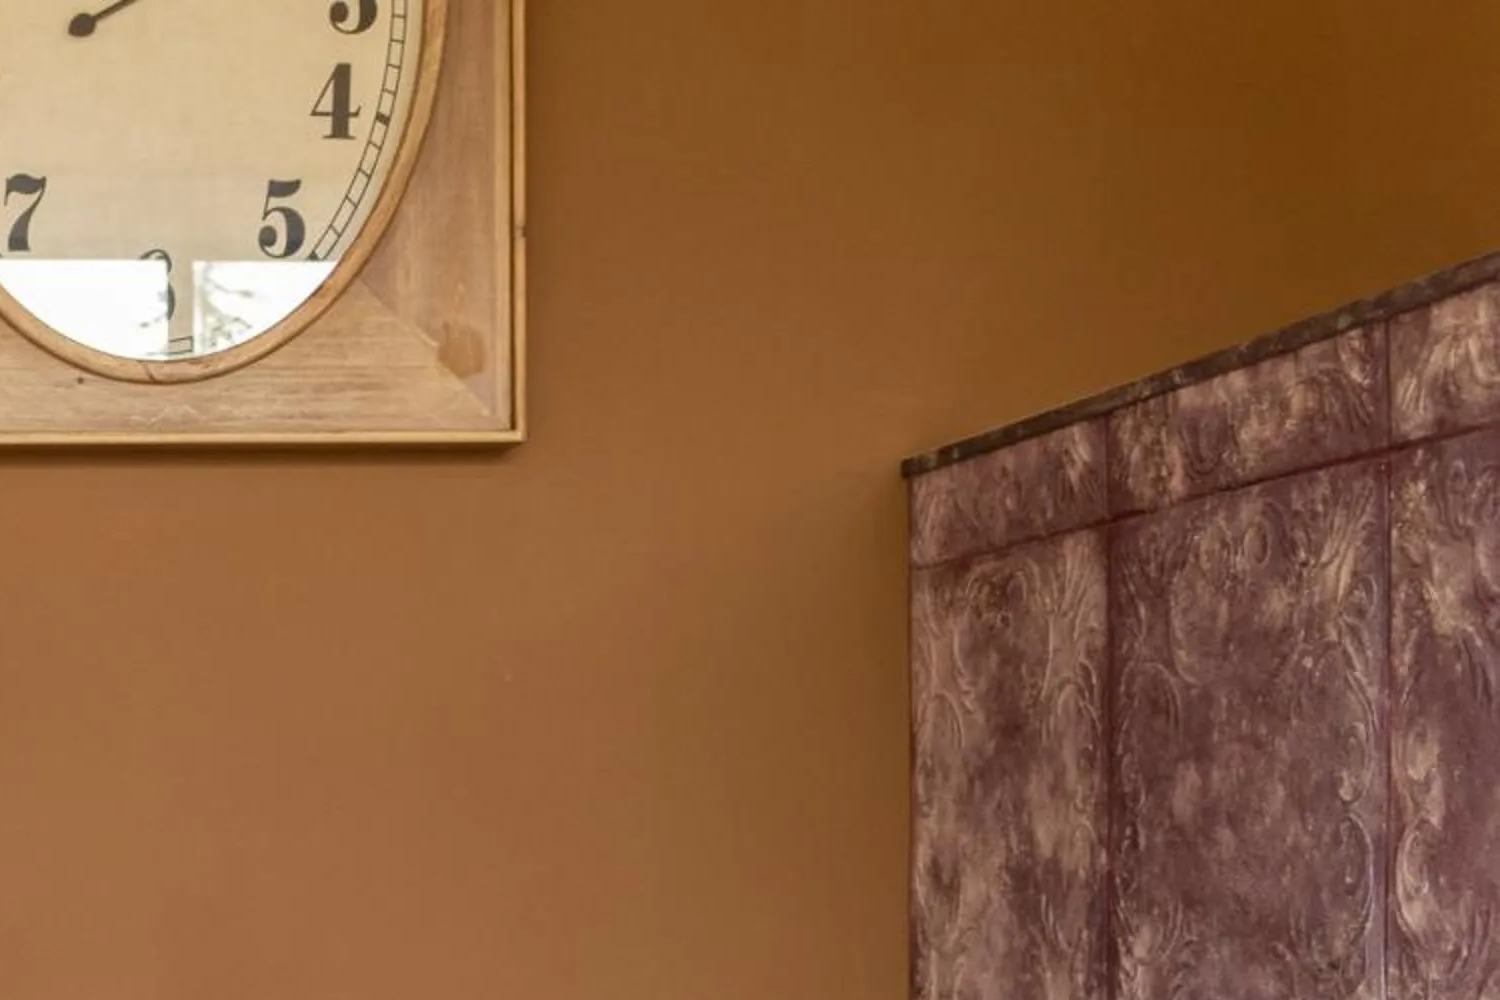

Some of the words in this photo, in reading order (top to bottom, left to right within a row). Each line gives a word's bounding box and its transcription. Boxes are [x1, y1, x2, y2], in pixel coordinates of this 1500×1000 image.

[309, 63, 361, 140] 4
[3, 173, 47, 251] 7
[257, 179, 306, 258] 5
